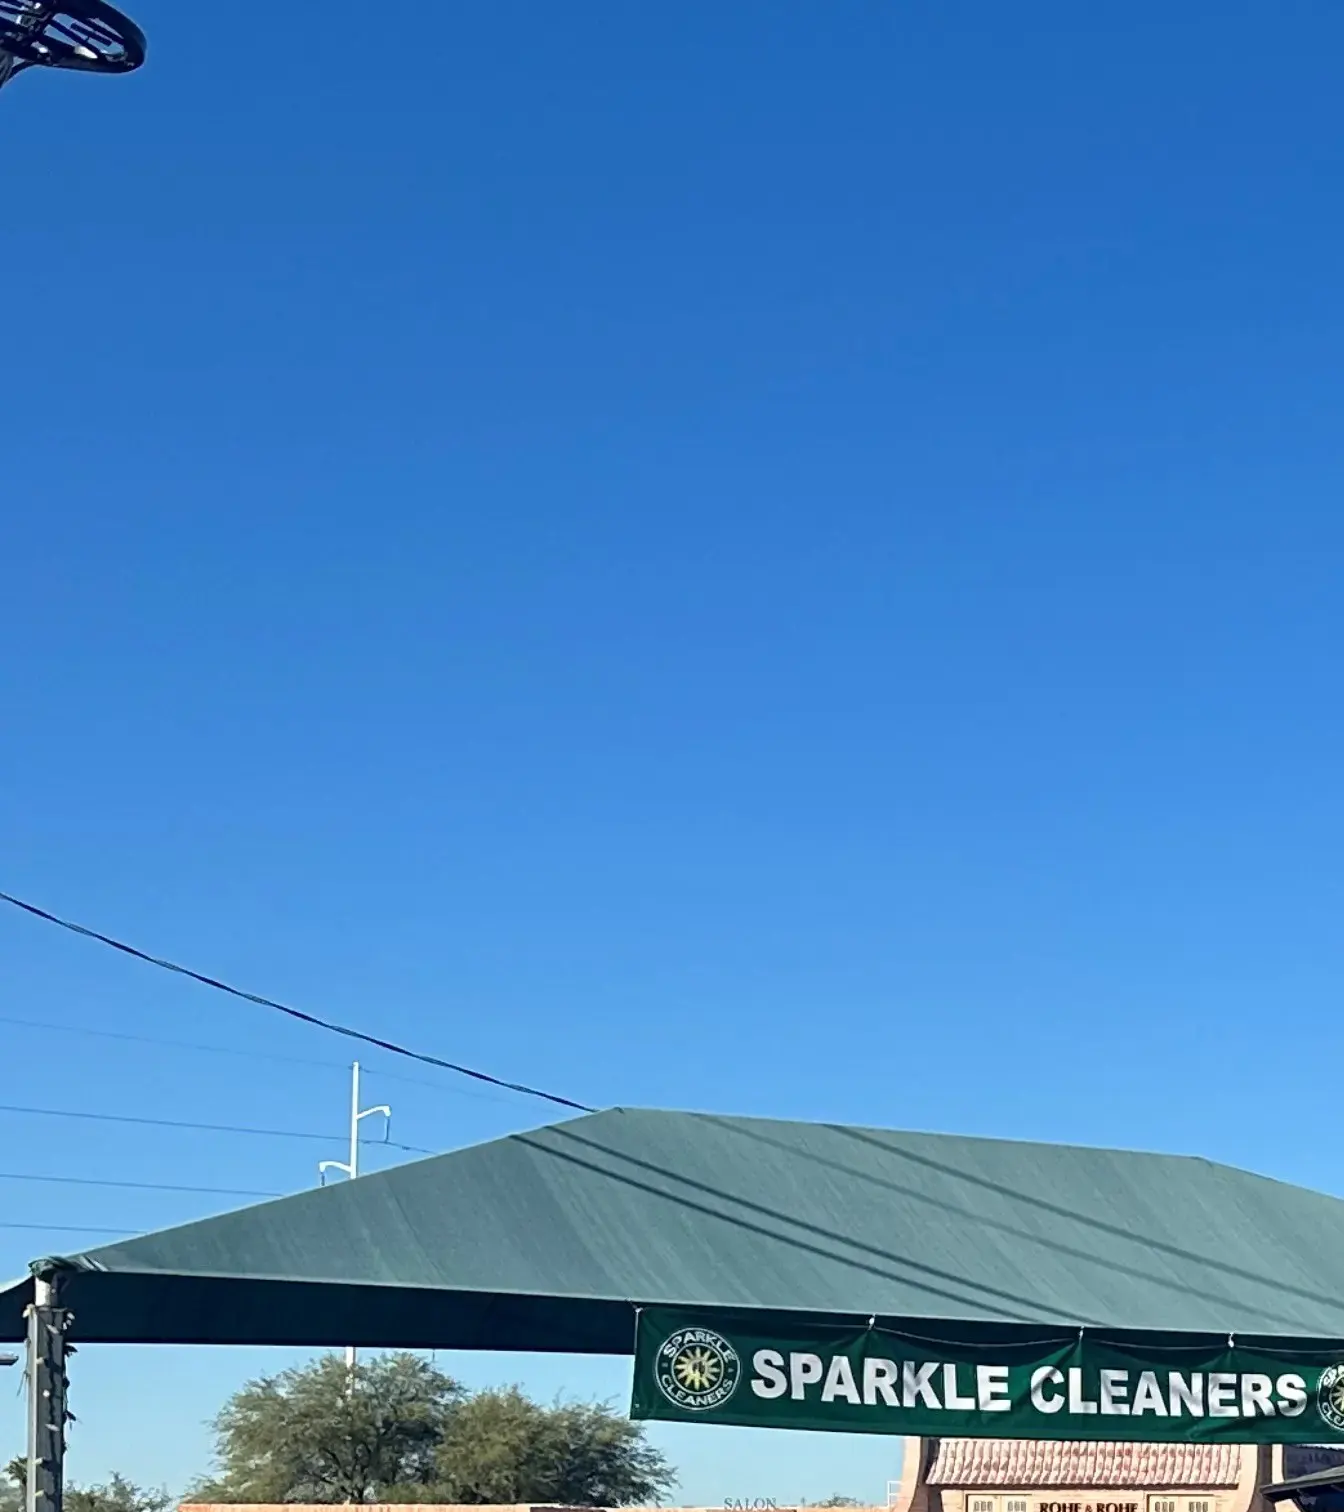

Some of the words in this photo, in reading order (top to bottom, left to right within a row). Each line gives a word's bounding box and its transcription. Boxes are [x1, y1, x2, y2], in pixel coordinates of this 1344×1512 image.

[663, 1331, 736, 1363] SPARKLE
[661, 1374, 733, 1406] CLEANERS
[751, 1349, 1011, 1412] SPARKLE
[1030, 1366, 1308, 1417] CLEANERS
[724, 1497, 778, 1511] SALON
